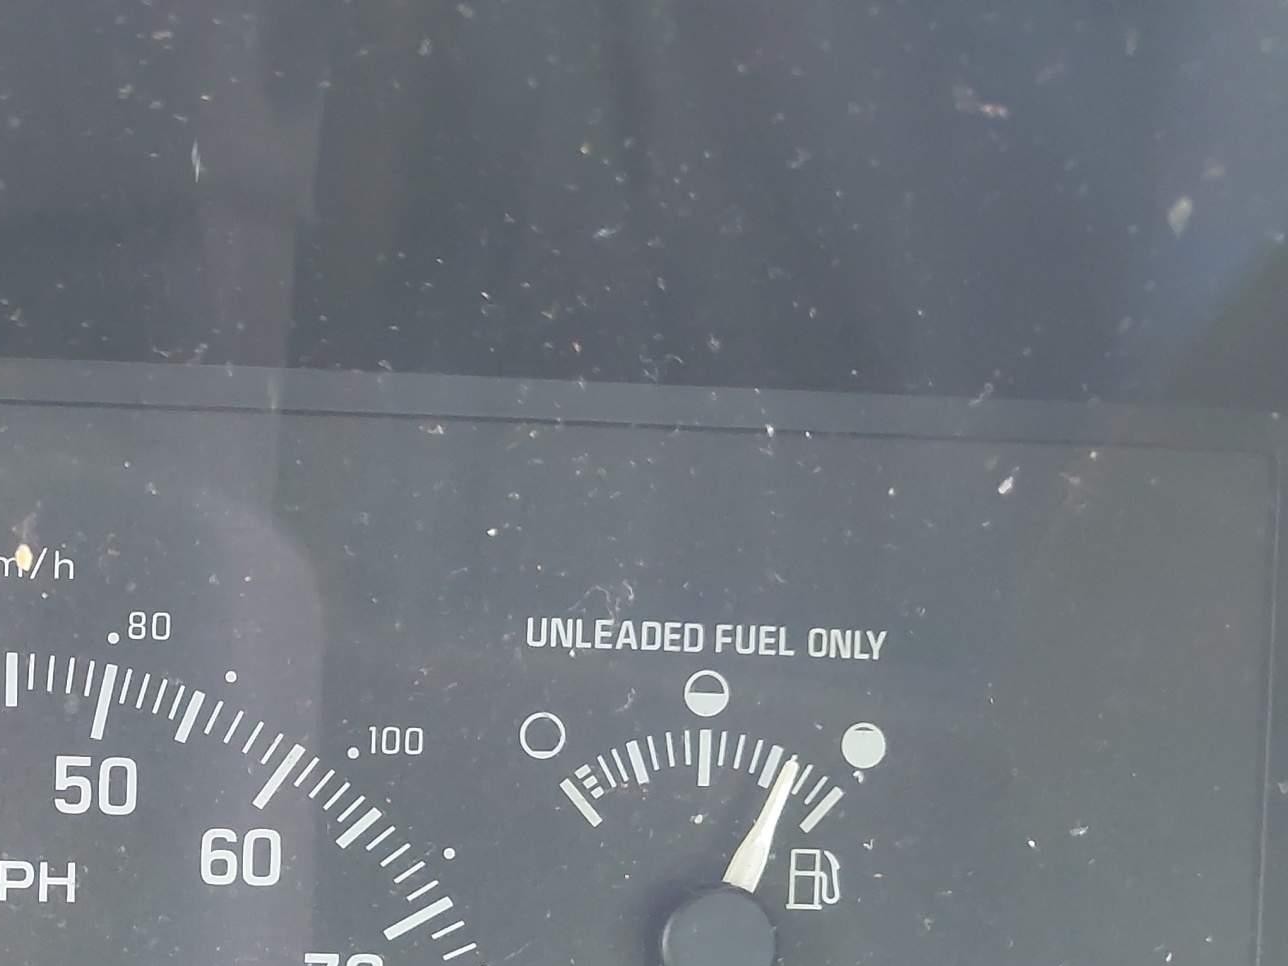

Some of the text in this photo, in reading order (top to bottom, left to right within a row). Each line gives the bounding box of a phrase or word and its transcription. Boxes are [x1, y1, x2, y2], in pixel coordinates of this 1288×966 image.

[129, 612, 170, 640] 80
[527, 618, 886, 659] UNLEADED FUEL ONLY
[370, 727, 423, 754] 100
[55, 756, 136, 815] 50
[201, 829, 281, 885] 60
